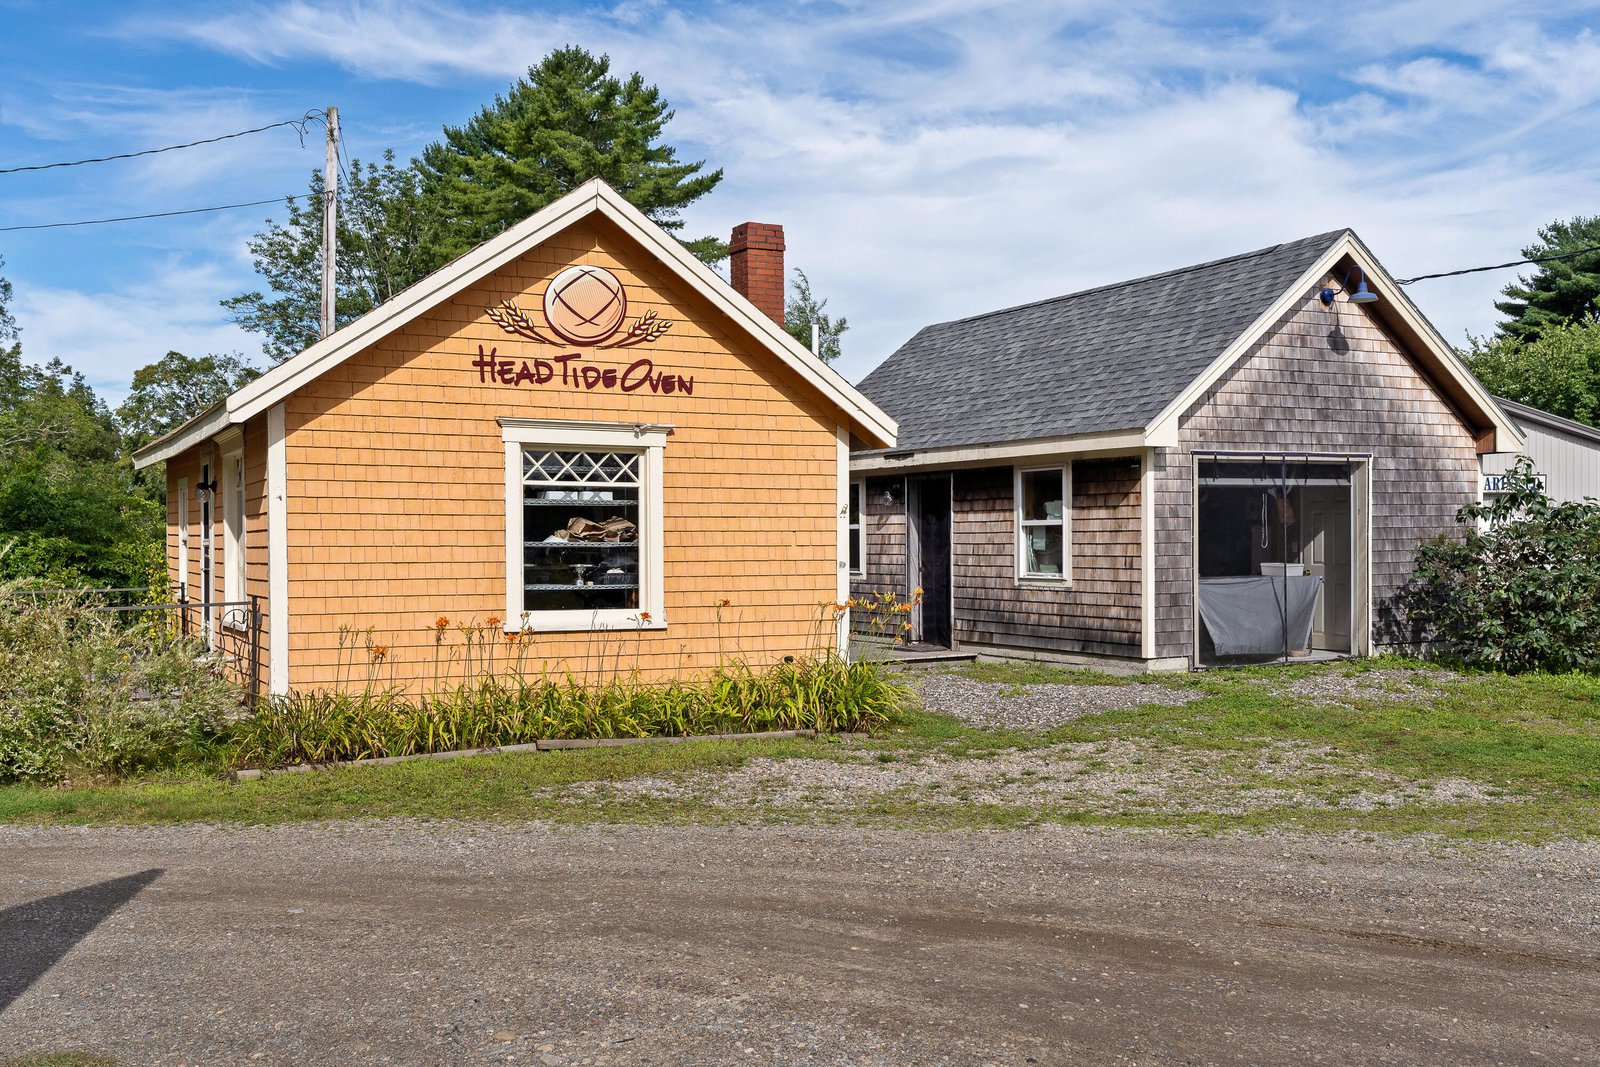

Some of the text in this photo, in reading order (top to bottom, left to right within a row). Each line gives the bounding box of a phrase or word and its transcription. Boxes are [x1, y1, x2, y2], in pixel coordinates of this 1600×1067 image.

[472, 344, 694, 395] HEAD TIDE OVEN
